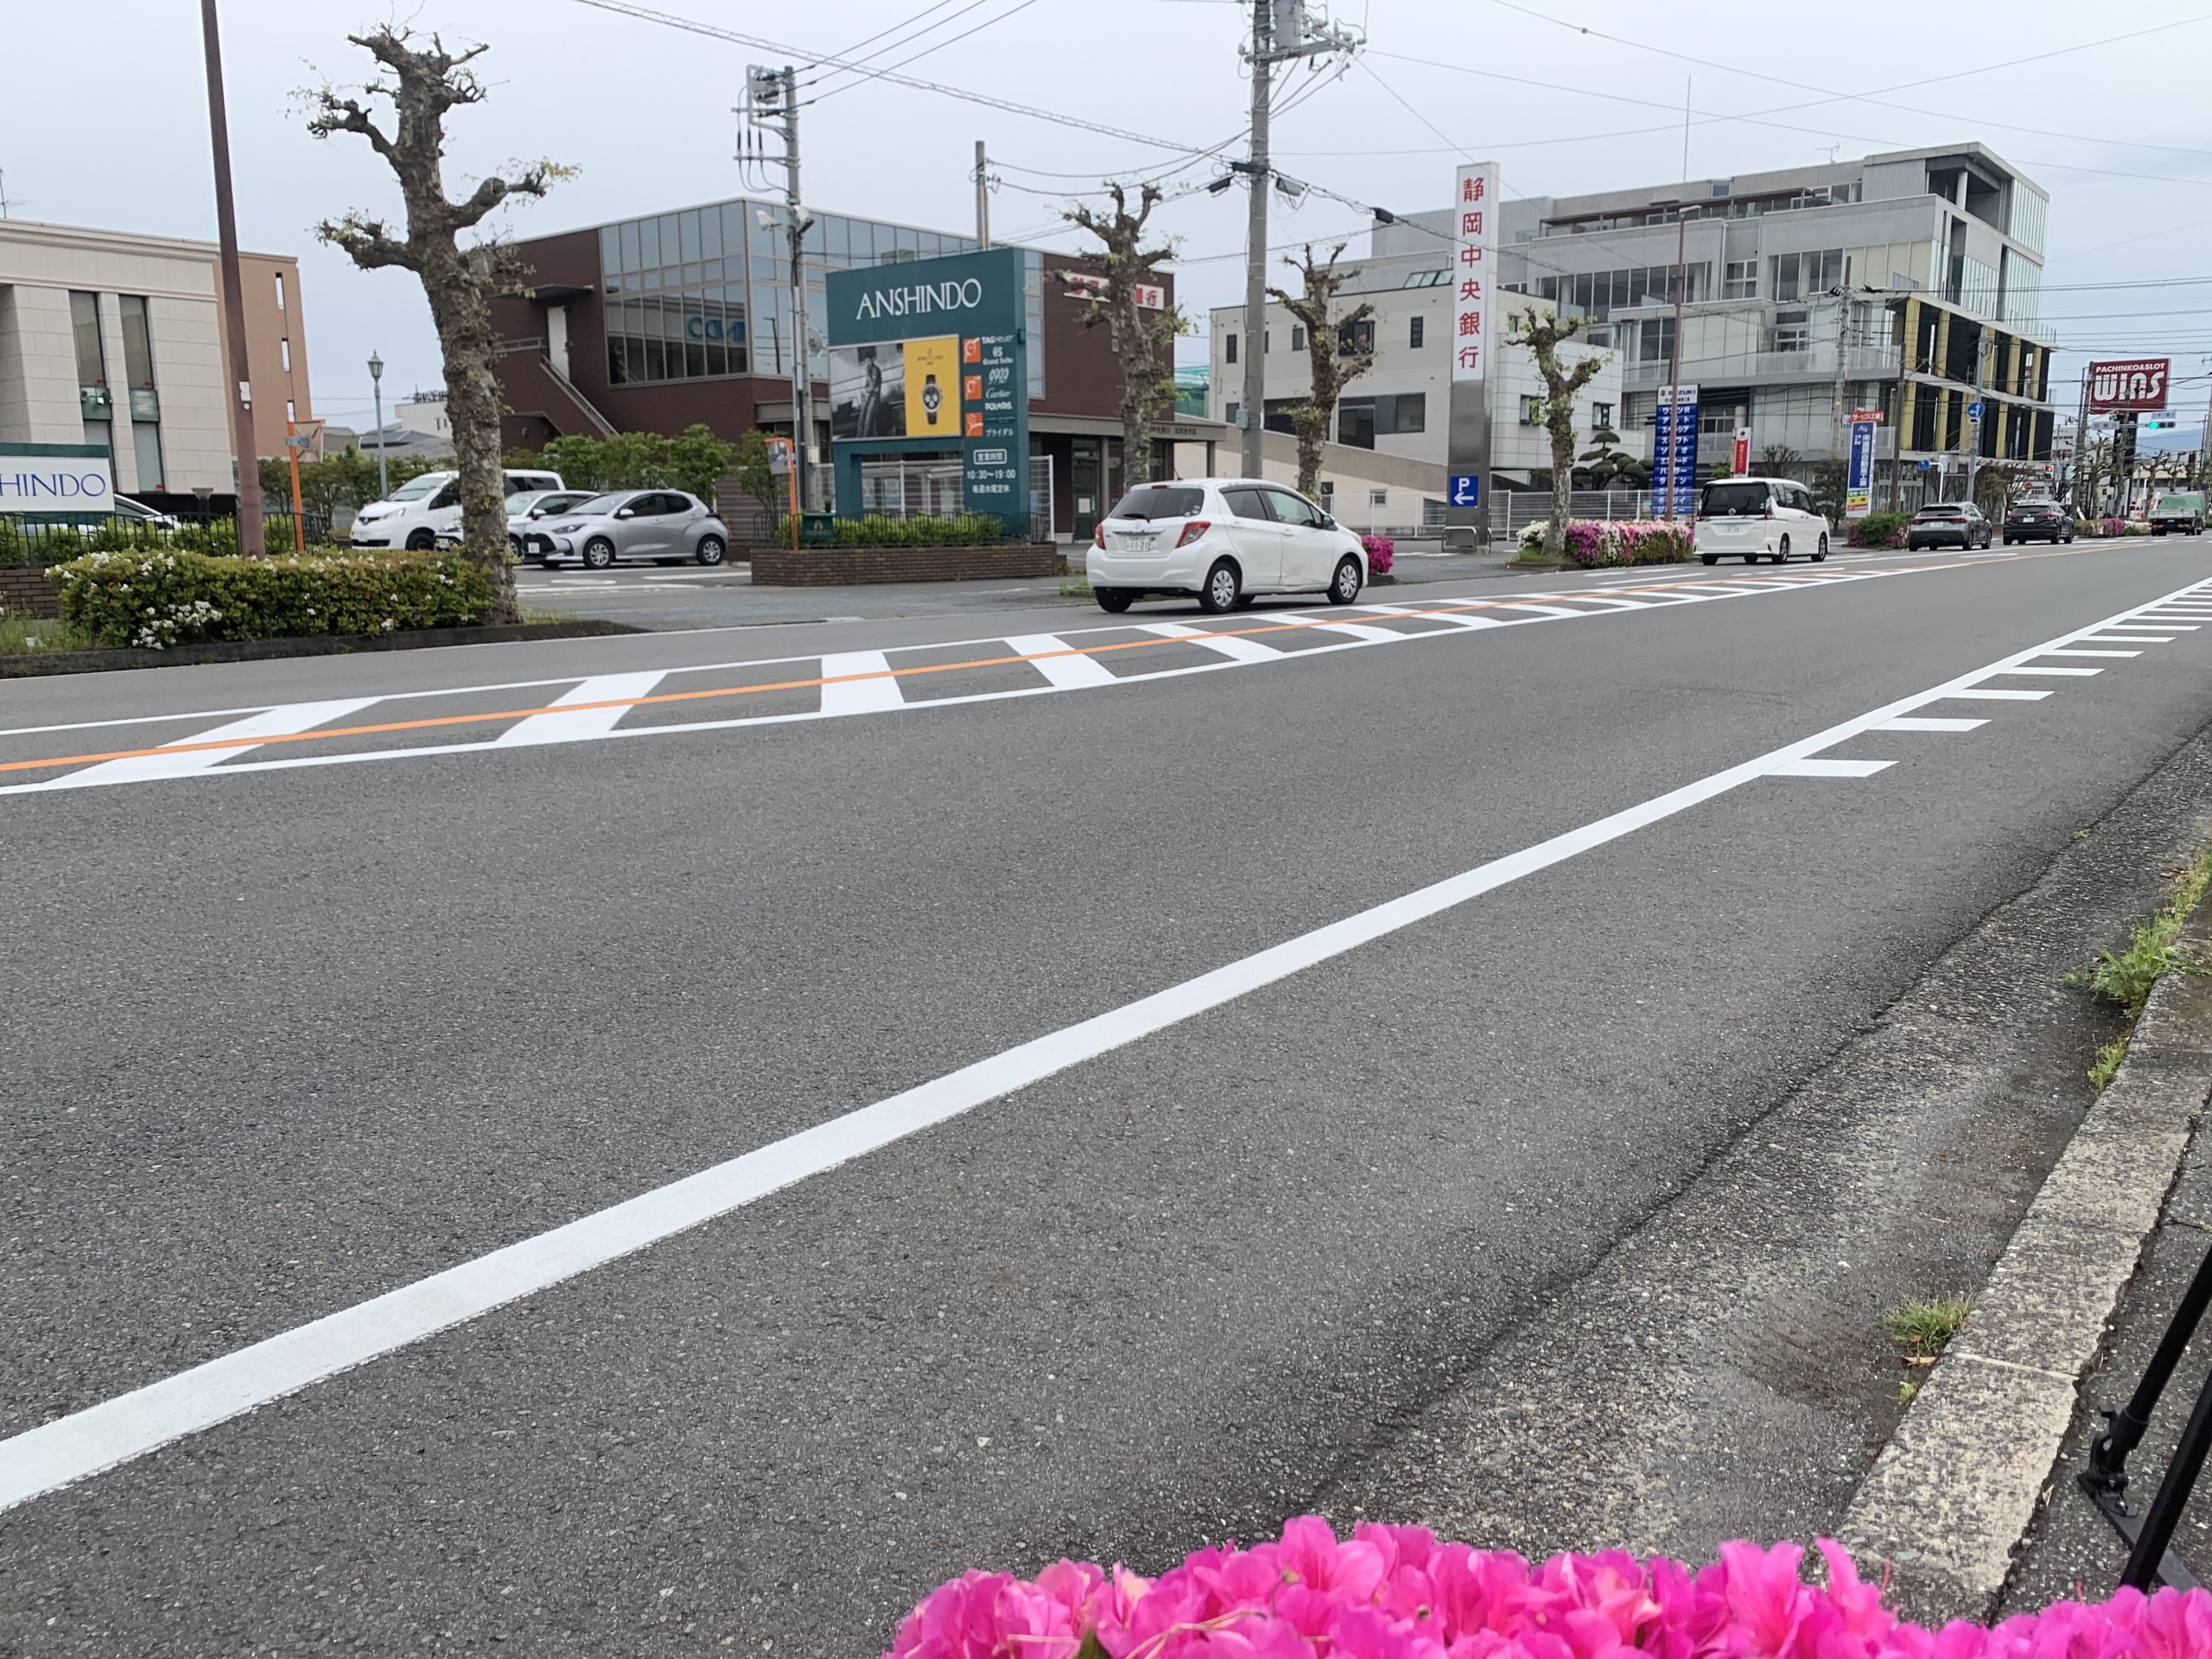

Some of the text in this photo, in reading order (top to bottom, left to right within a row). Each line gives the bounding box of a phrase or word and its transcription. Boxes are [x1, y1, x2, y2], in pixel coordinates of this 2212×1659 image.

[1459, 177, 1484, 369] 静岡中央銀行
[855, 277, 982, 320] ANSHINDO
[2095, 363, 2165, 373] PACHINKO&SLOT
[985, 387, 1012, 399] Cartier
[1662, 405, 1690, 415] ワンR
[1662, 416, 1689, 424] アト
[0, 474, 105, 497] HINDO
[1459, 478, 1470, 492] P
[1658, 496, 1686, 505] キリイ
